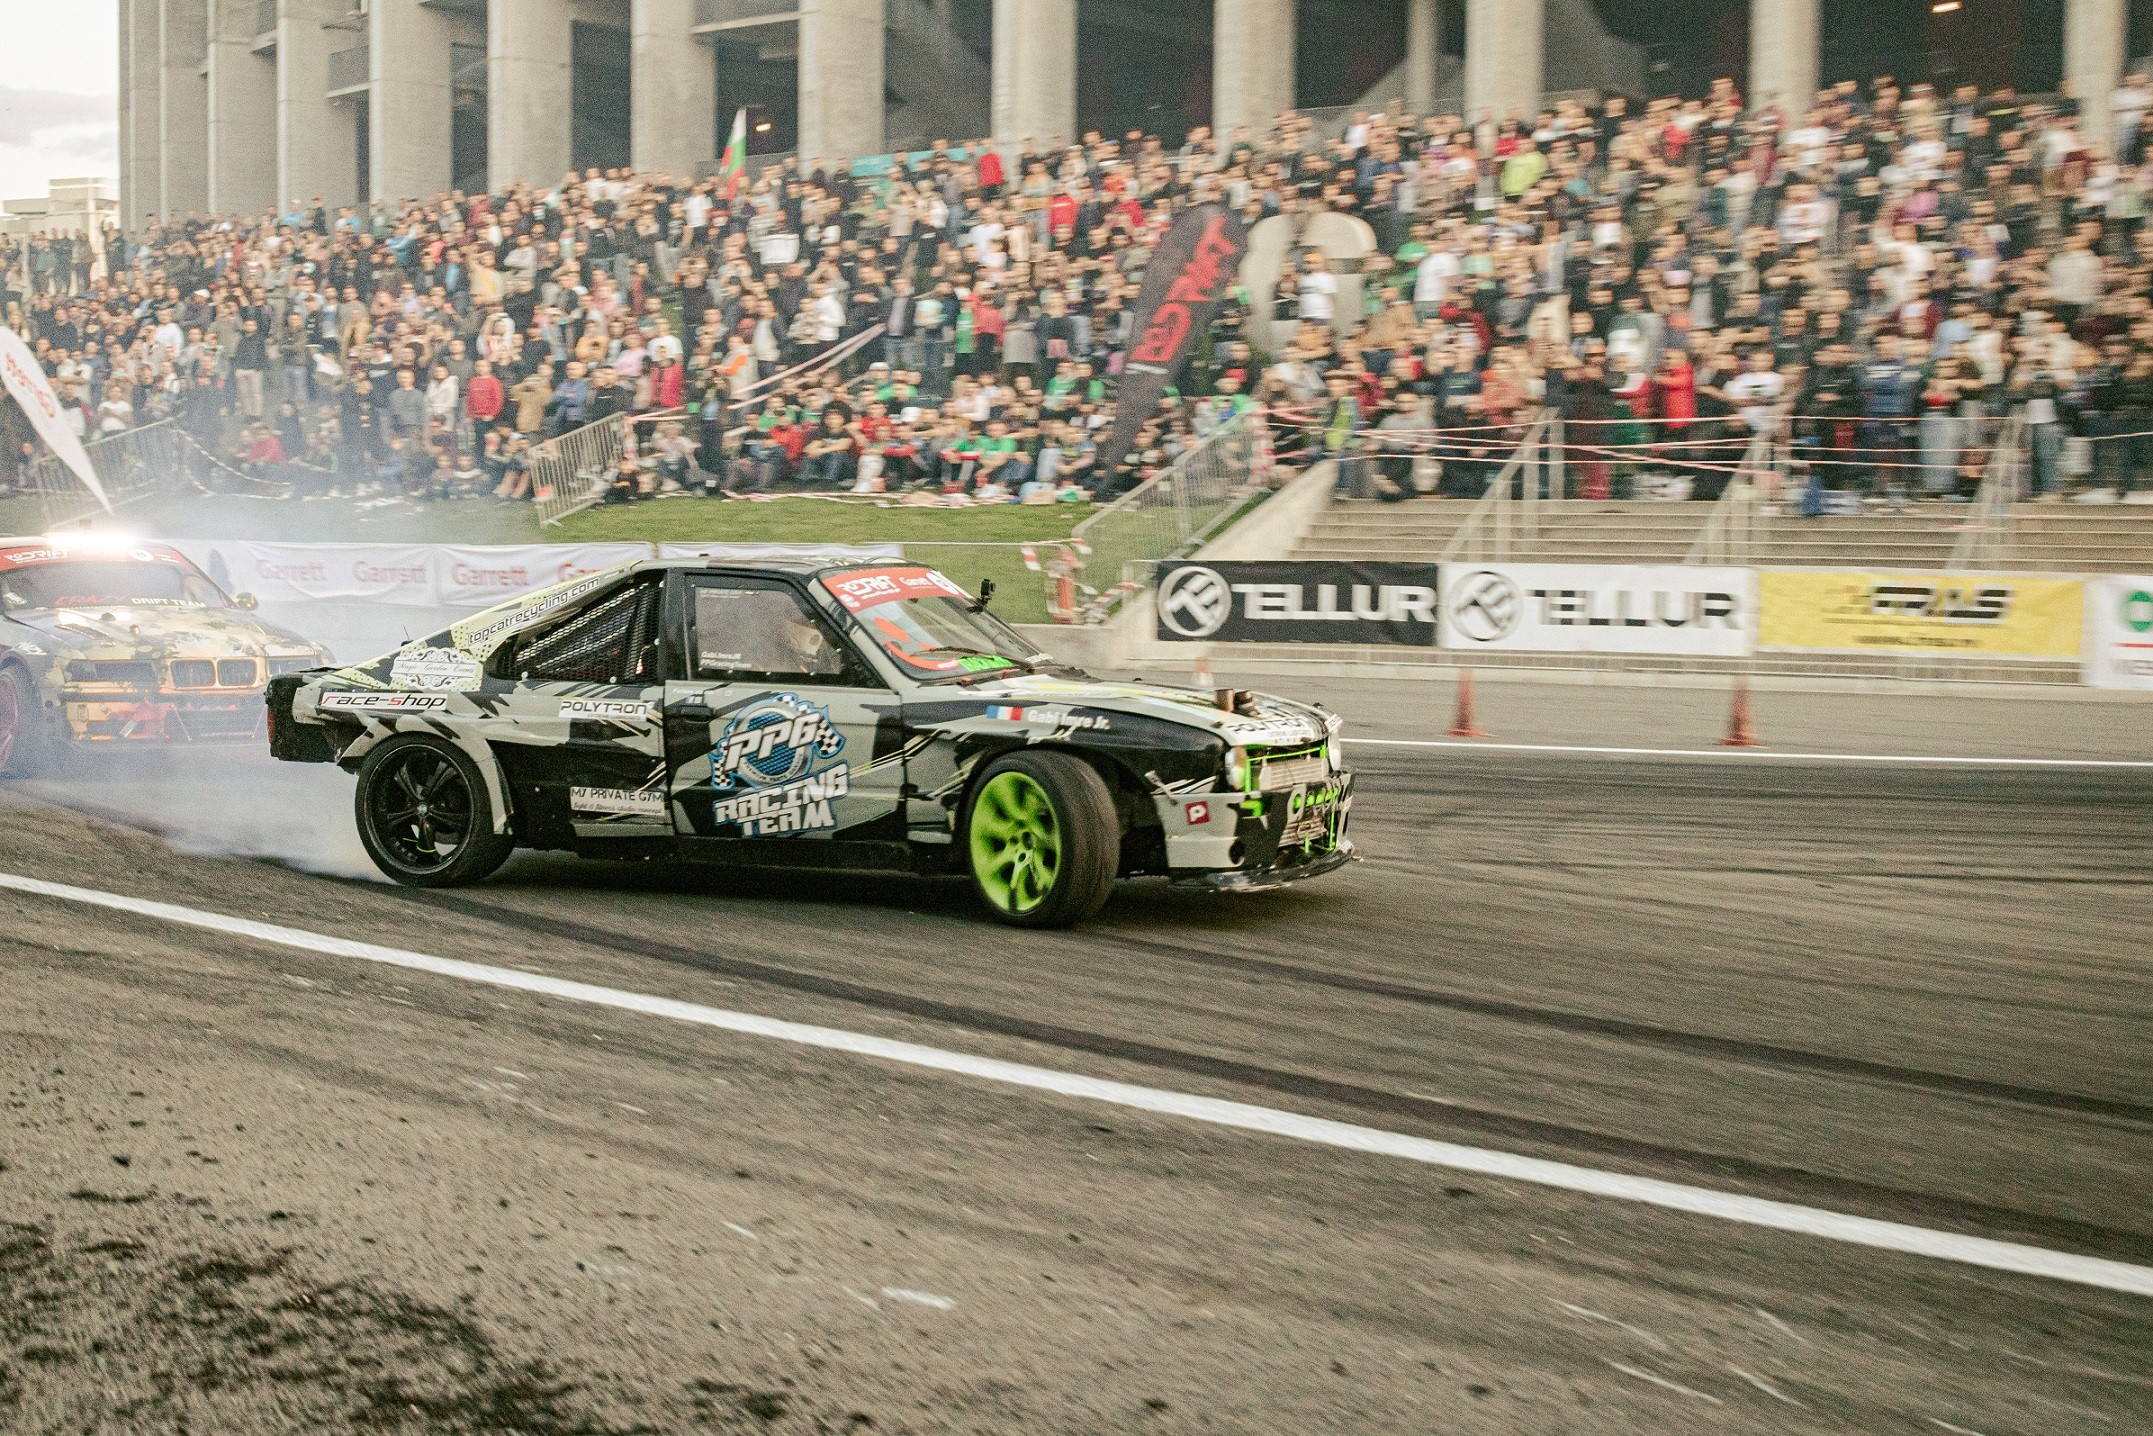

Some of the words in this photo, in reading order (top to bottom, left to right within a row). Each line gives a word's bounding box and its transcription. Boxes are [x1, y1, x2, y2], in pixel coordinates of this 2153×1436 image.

[257, 559, 325, 583] Garrett
[352, 560, 427, 585] Garrett
[452, 563, 530, 587] Garrett
[131, 597, 169, 606] DRIFT
[171, 599, 206, 608] TEAM
[468, 576, 600, 646] topcatrecycling.com
[1232, 583, 1438, 622] TELLUR
[1525, 590, 1741, 629] TELLUR
[322, 694, 447, 710] race-shop
[561, 701, 647, 715] POLYTRON
[1027, 709, 1060, 724] Gabi
[723, 712, 820, 773] PPG
[590, 788, 636, 801] PRIVATE
[714, 763, 849, 824] RACING
[739, 800, 834, 836] TEAM
